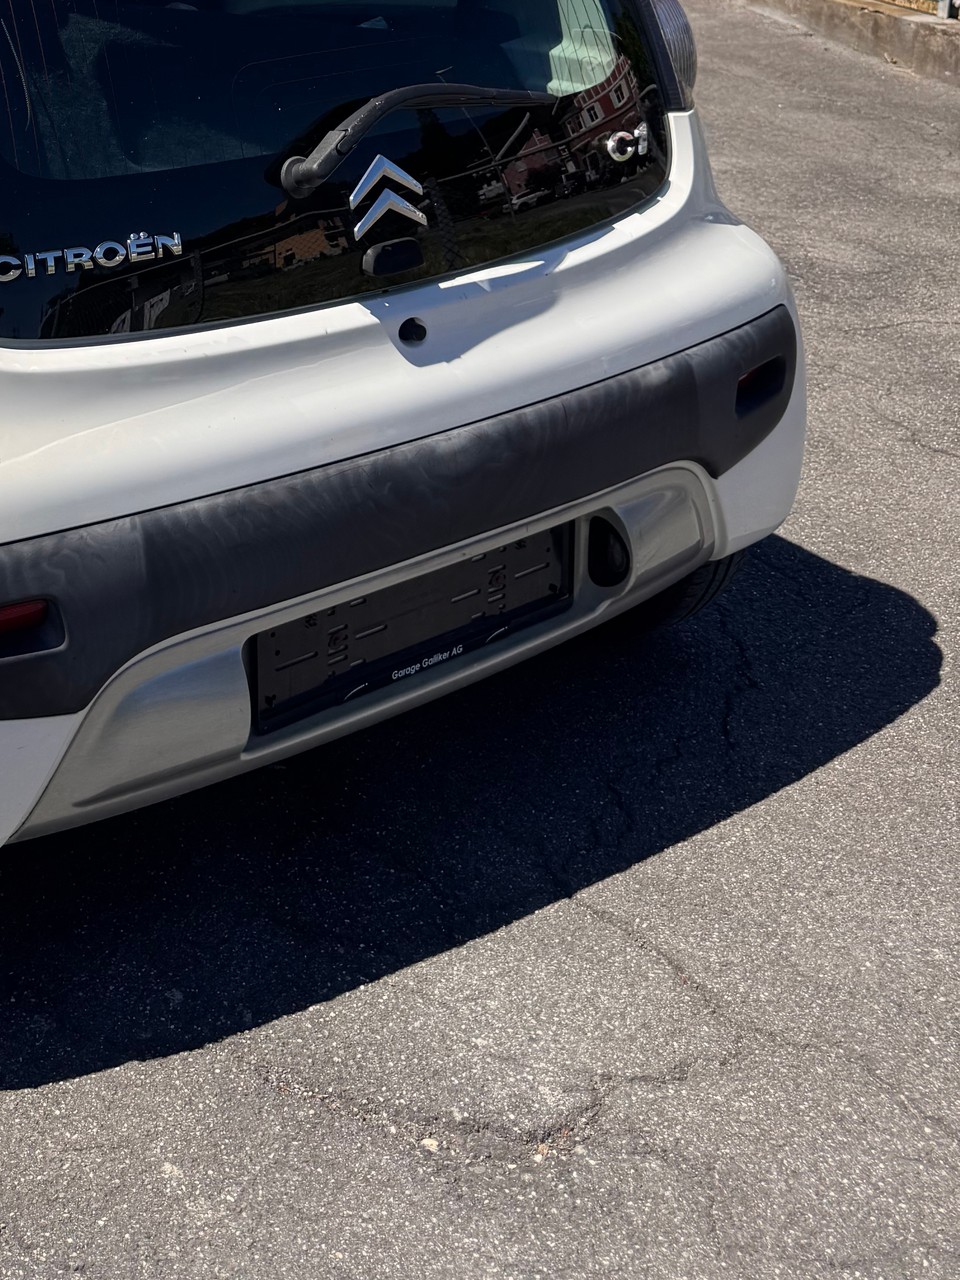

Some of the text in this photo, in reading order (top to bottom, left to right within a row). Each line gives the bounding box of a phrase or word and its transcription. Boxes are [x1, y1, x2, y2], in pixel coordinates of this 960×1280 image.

[606, 121, 648, 162] C1
[391, 644, 464, 680] Garage Galliker AG
